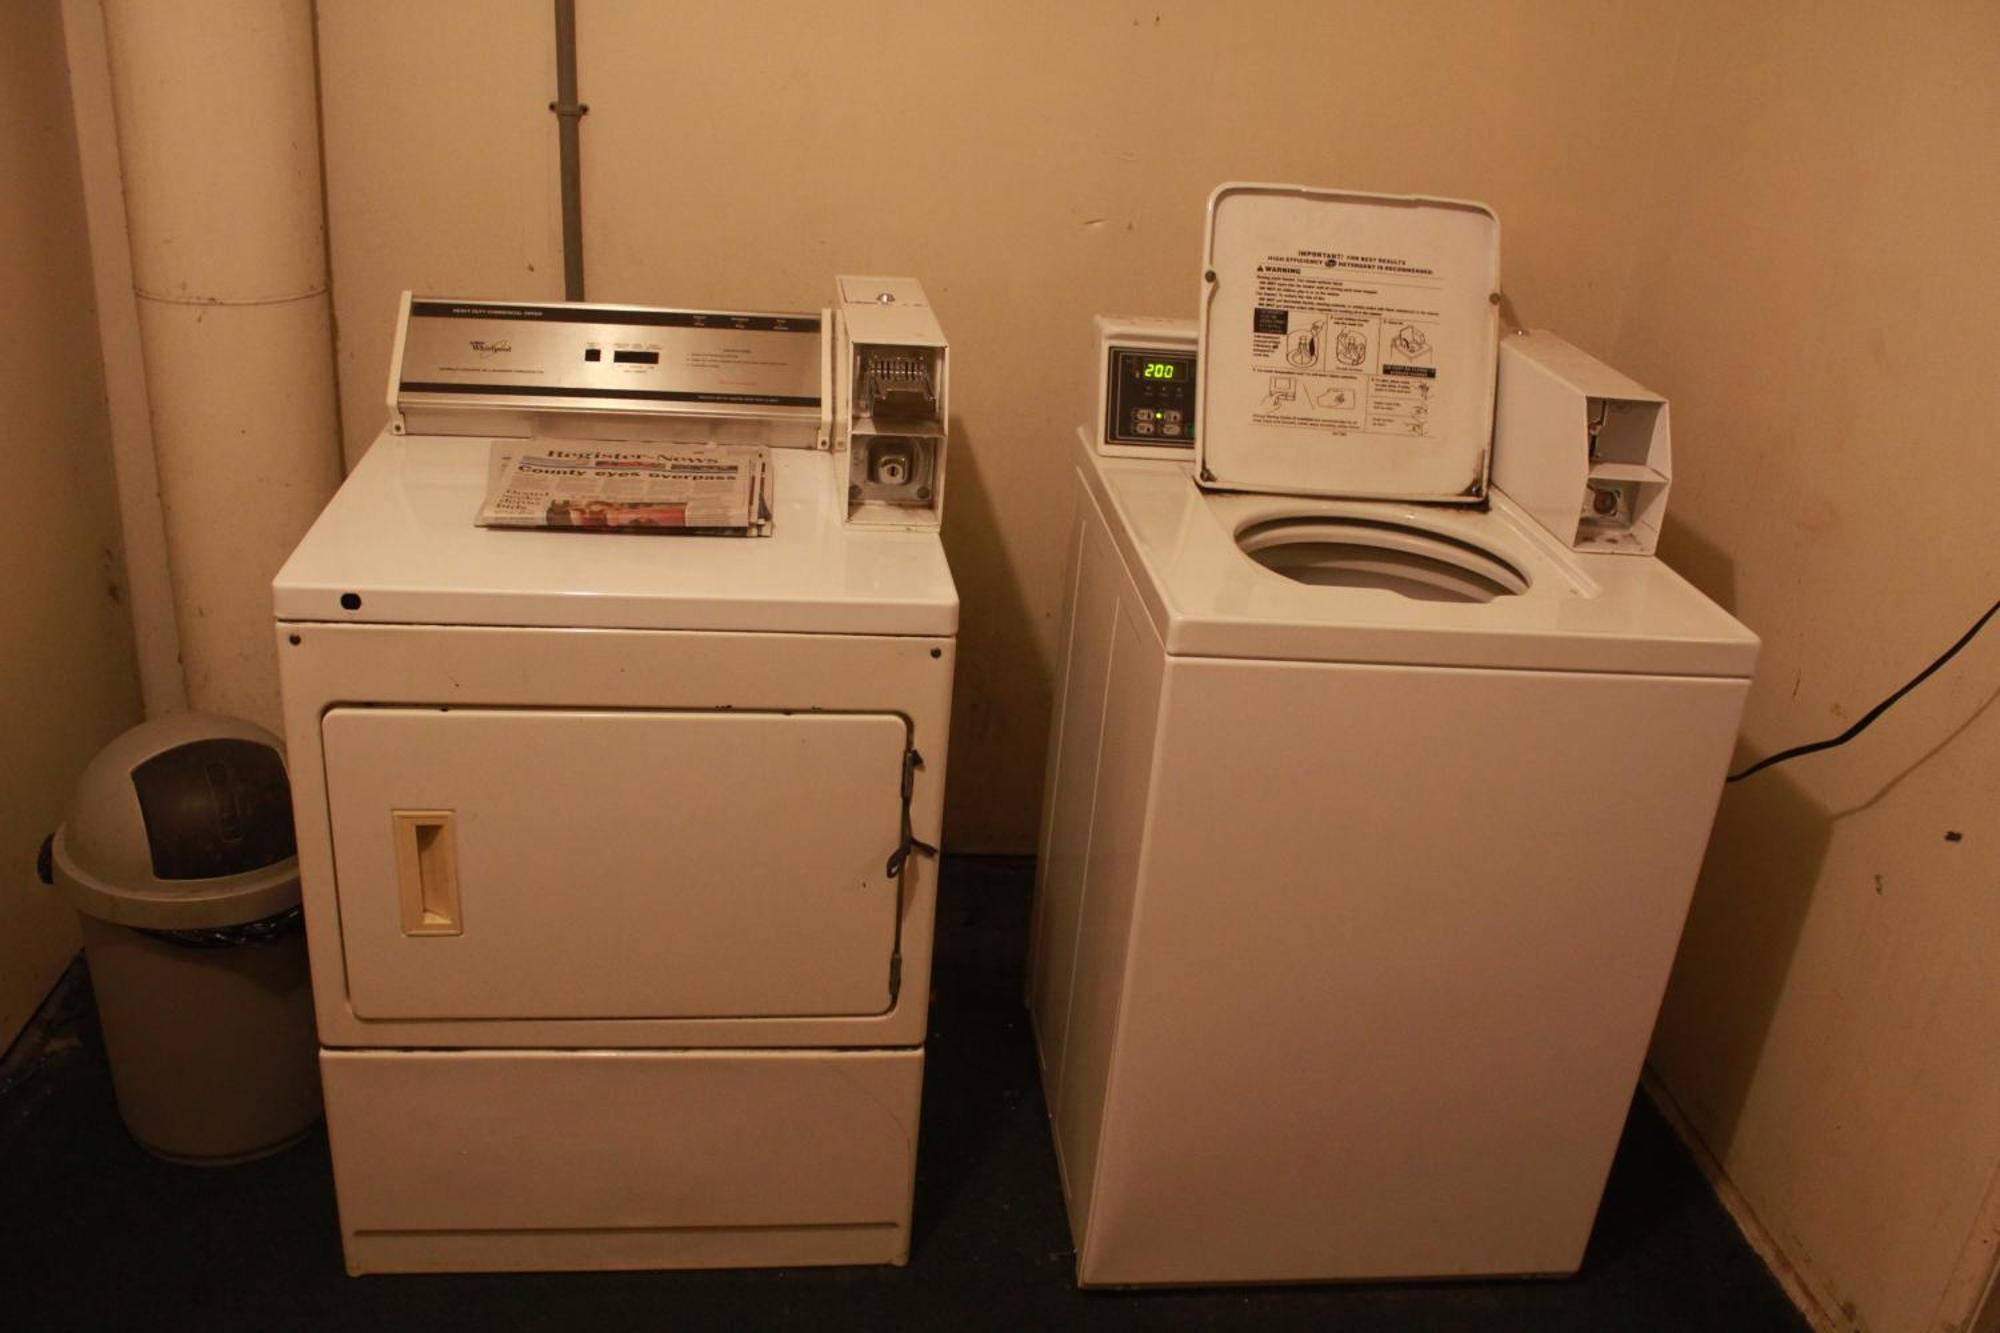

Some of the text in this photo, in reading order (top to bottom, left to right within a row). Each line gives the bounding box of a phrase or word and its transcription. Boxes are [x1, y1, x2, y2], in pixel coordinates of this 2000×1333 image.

[1265, 266, 1301, 274] WARNING
[472, 343, 512, 354] Whirlpool
[1144, 363, 1174, 378] 200
[518, 465, 586, 476] County
[648, 472, 736, 481] overpass
